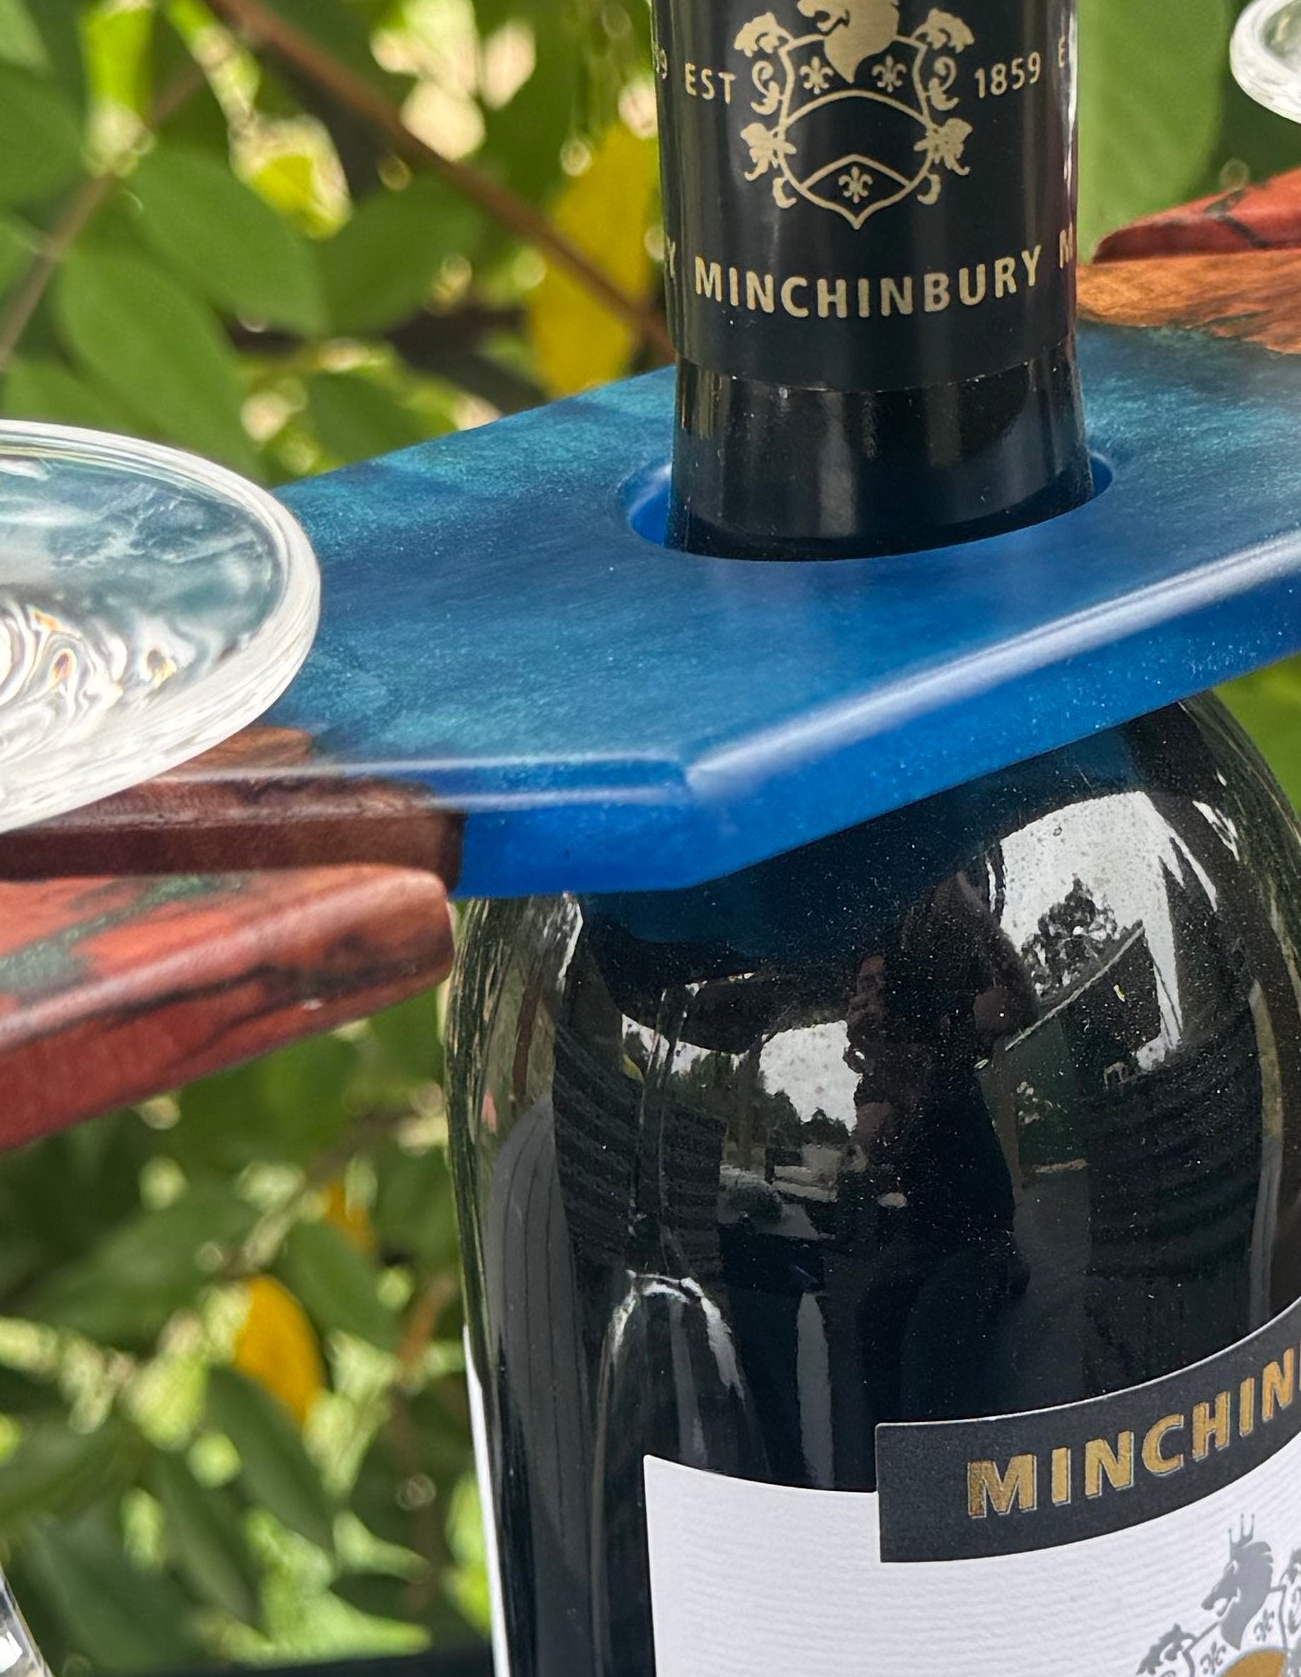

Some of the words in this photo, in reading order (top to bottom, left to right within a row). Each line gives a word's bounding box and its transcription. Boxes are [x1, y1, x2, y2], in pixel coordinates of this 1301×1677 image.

[684, 63, 736, 105] EST
[973, 51, 1043, 100] 1859
[693, 245, 1042, 319] MINCHINBURY
